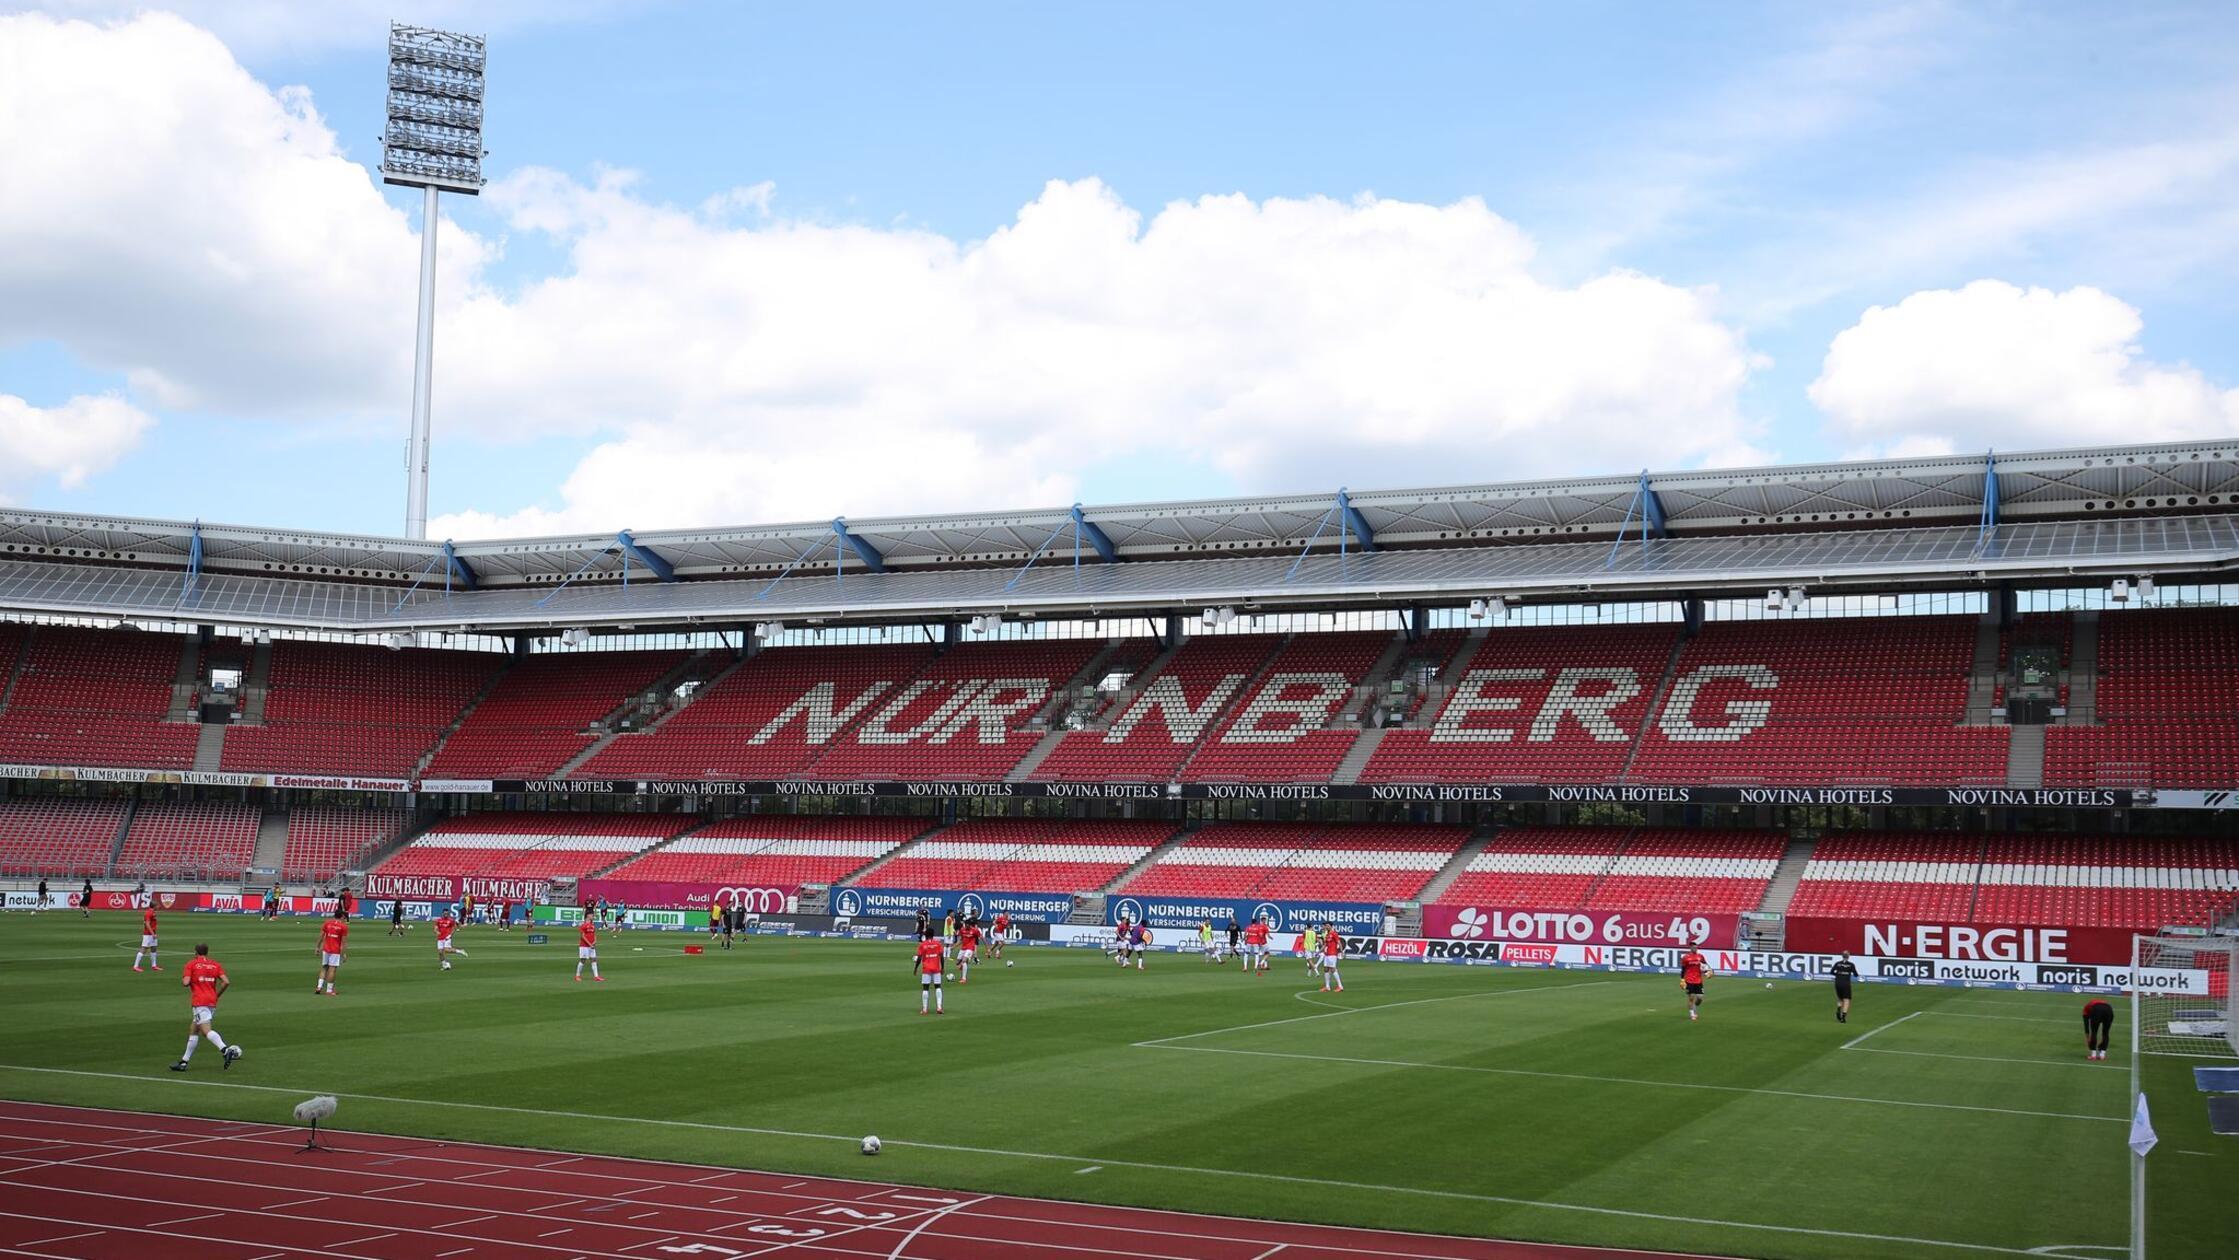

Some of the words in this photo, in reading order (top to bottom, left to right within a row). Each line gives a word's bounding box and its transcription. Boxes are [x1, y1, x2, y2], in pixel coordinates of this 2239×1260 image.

[77, 768, 145, 781] KULMBACHER
[184, 772, 250, 785] KULMBACHER
[274, 777, 348, 788] Edelmetalle
[352, 780, 405, 791] Hanauer
[425, 783, 489, 793] www.gold-hanauer.de
[525, 781, 568, 792] NOVINA
[571, 782, 613, 792] HOTELS
[652, 782, 697, 793] NOVINA
[701, 783, 745, 794] HOTELS
[776, 782, 824, 794] NOVINA
[827, 783, 875, 794] HOTELS
[907, 783, 957, 795] NOVINA
[962, 784, 1012, 796] HOTELS
[1046, 784, 1100, 796] NOVINA
[1104, 785, 1158, 797] HOTELS
[1208, 786, 1266, 798] NOVINA
[1270, 786, 1329, 798] HOTELS
[1372, 786, 1435, 799] NOVINA
[1440, 787, 1502, 800] HOTELS
[1549, 788, 1616, 800] NOVINA
[1622, 788, 1689, 801] HOTELS
[1740, 789, 1814, 802] NOVINA
[1819, 790, 1892, 803] HOTELS
[1948, 790, 2028, 804] NOVINA
[2034, 791, 2115, 805] HOTELS
[367, 874, 452, 896] KULMBACHER
[9, 895, 56, 905] netwk
[687, 893, 710, 903] Audi
[866, 895, 942, 908] NÜRNBERGER
[375, 901, 432, 916] SYSEAM
[989, 899, 1069, 912] NÜRNBERGER
[1148, 904, 1234, 918] NÜRNBERGER
[1148, 918, 1205, 927] VERSICHERUN
[1289, 909, 1380, 923] NÜRNBERGER
[1493, 911, 1594, 941] LOTTO
[1385, 942, 1420, 954] HEIZÖL
[1427, 941, 1500, 960] ROSA
[1506, 947, 1551, 961] PELLETS
[1884, 961, 1929, 977] noris
[1941, 965, 2020, 981] network
[2043, 968, 2091, 984] noris
[748, 1224, 825, 1237] 3
